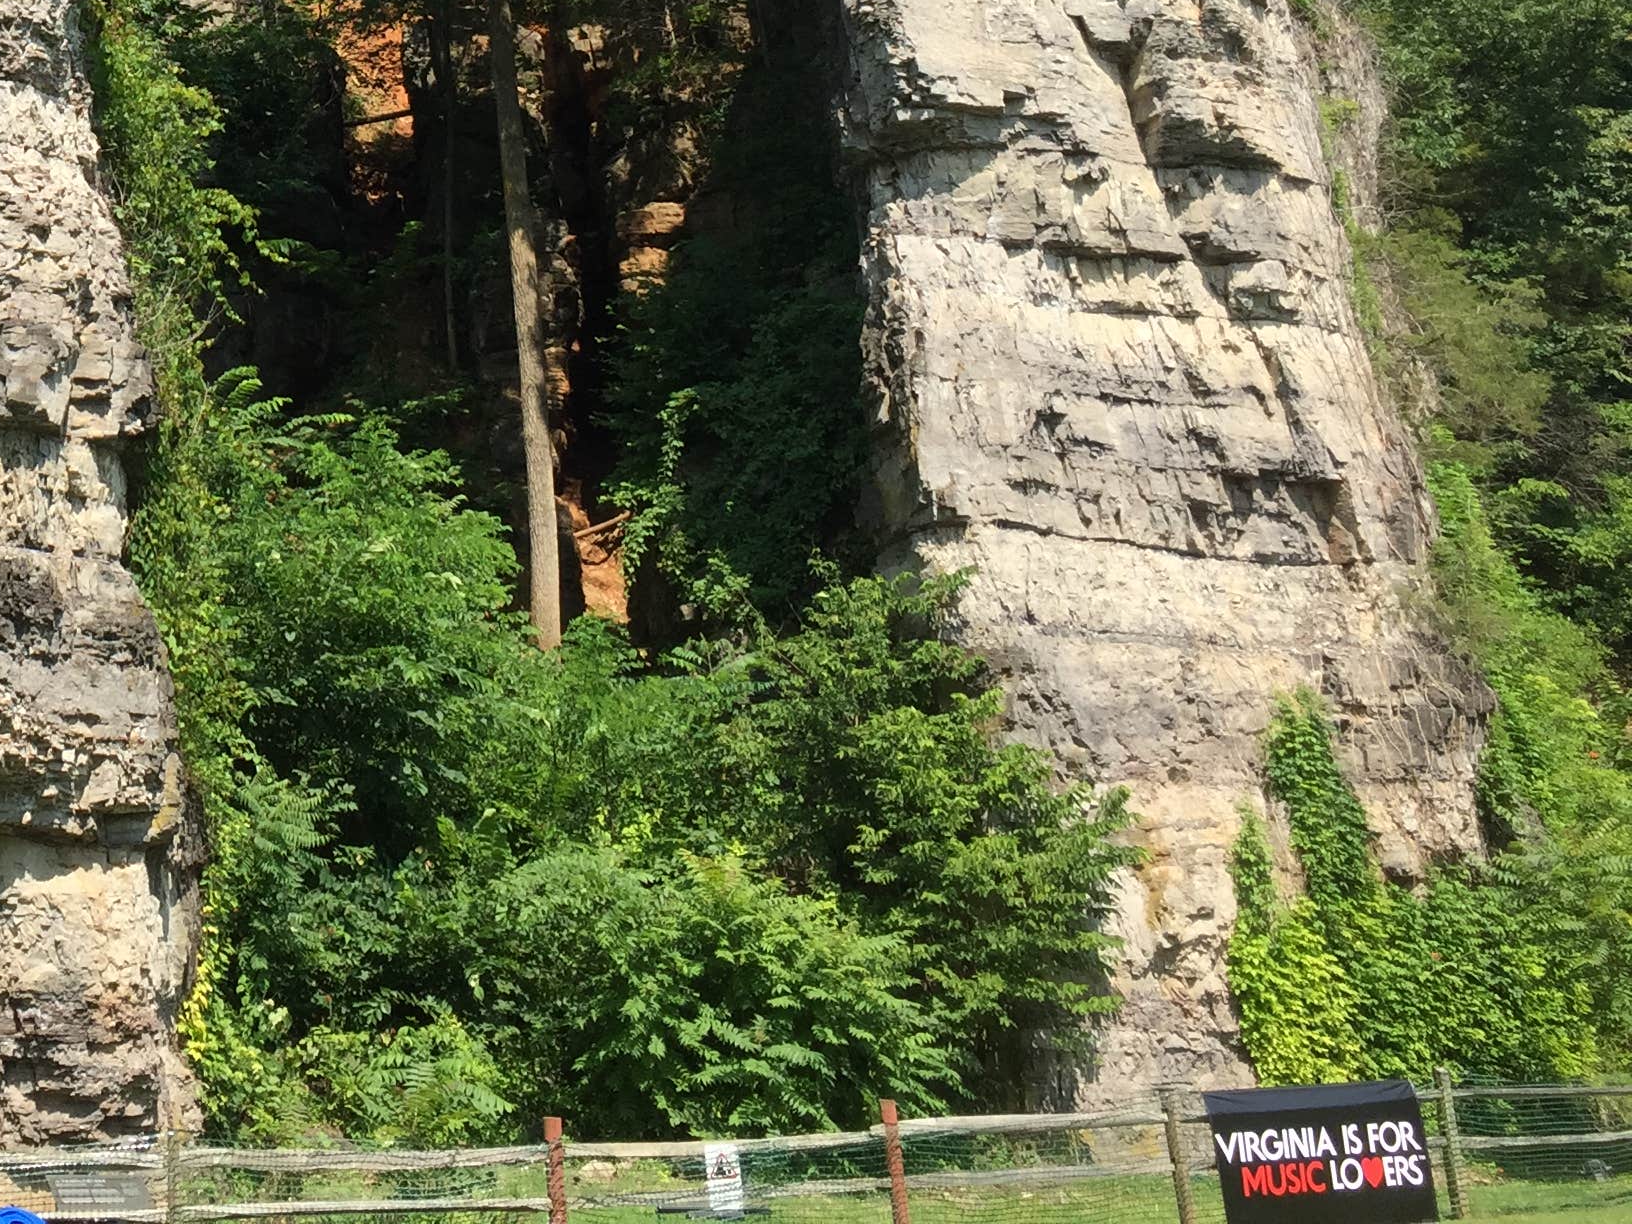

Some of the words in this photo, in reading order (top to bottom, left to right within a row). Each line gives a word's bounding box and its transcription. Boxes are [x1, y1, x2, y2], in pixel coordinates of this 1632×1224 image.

[1214, 1126, 1338, 1164] VIRGINIA
[1341, 1124, 1363, 1155] IS
[1366, 1121, 1422, 1154] FOR
[1240, 1160, 1327, 1197] MUSIC
